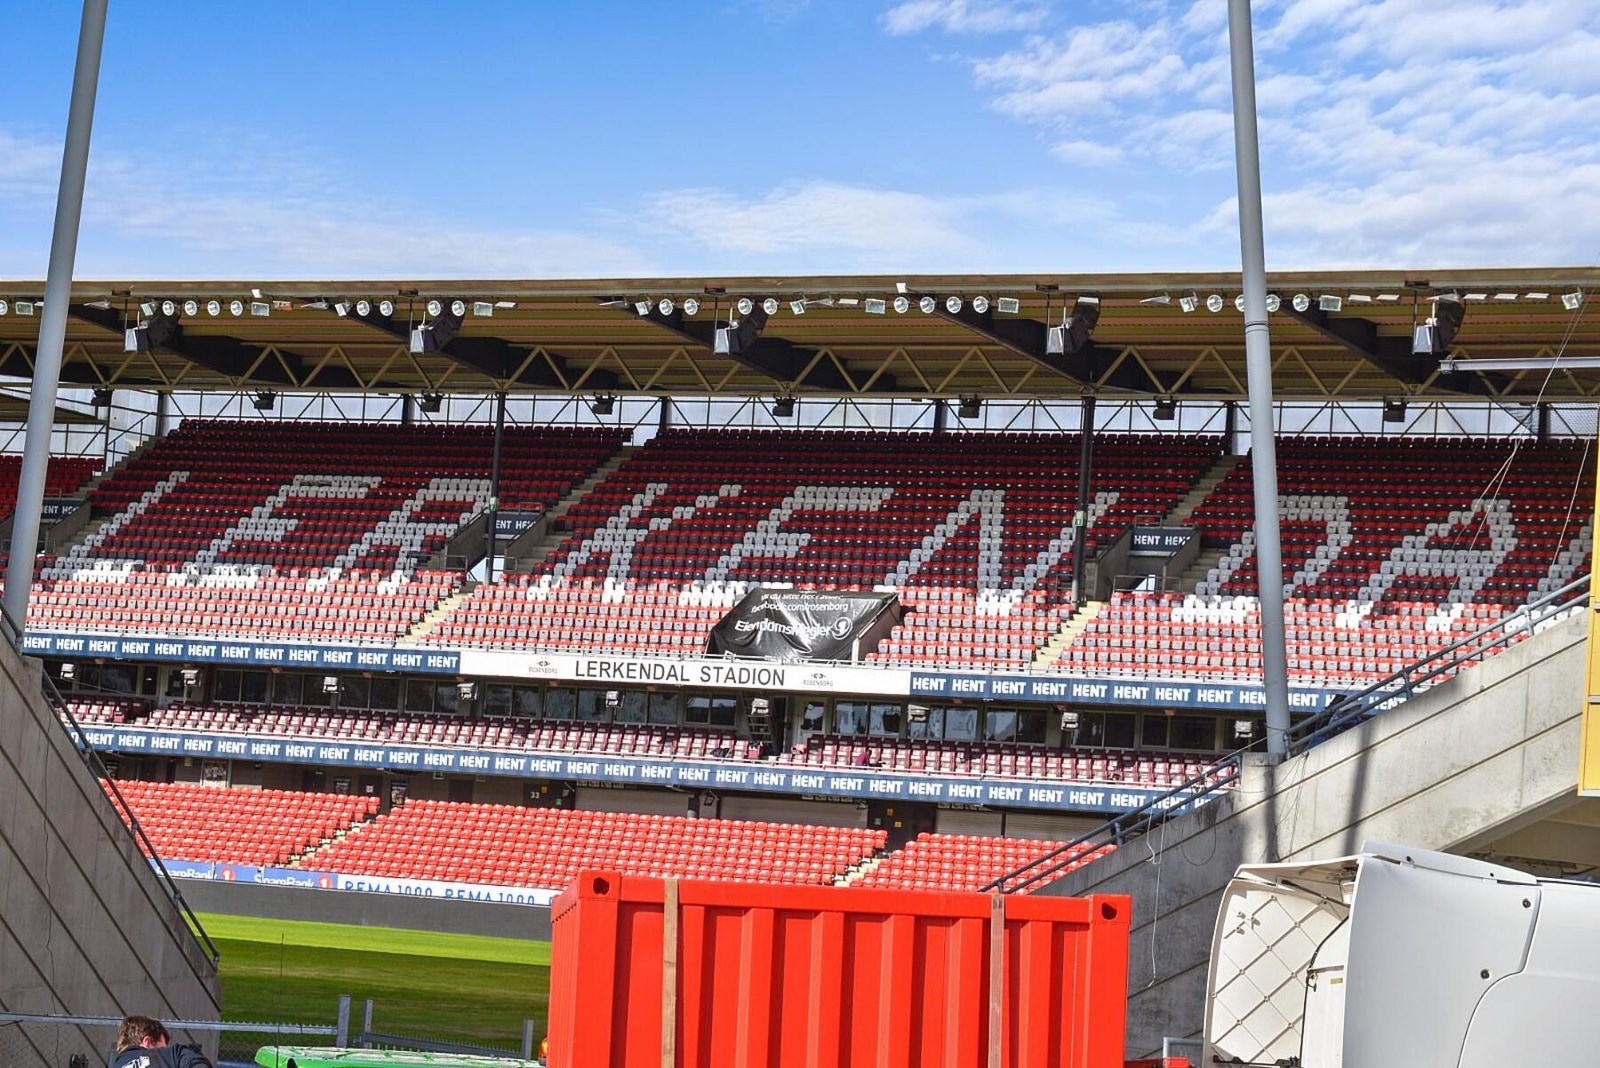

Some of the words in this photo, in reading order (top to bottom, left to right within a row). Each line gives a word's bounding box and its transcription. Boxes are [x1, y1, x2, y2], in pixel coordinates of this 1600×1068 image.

[40, 505, 59, 515] ENT
[1133, 534, 1161, 546] HENT
[23, 636, 52, 649] HENT
[56, 638, 85, 651] HENT
[88, 640, 118, 653] HENT
[121, 641, 150, 654] HENT
[154, 643, 184, 656] HENT
[188, 644, 217, 657] HENT
[221, 646, 251, 659] HENT
[255, 647, 284, 661] HENT
[289, 649, 319, 662] HENT
[323, 650, 353, 664] HENT
[357, 652, 388, 665] HENT
[392, 653, 423, 667] HENT
[427, 655, 458, 668] HENT
[574, 660, 690, 682] LERKENDAL
[699, 665, 785, 686] STADION
[912, 677, 947, 691] HENT
[951, 678, 987, 693] HENT
[992, 680, 1027, 694] HENT
[1032, 682, 1067, 696] HENT
[1072, 683, 1108, 698] HENT
[1113, 685, 1150, 700] HENT
[1155, 687, 1191, 702] HENT
[1197, 689, 1234, 703] HENT
[1239, 690, 1267, 705] HEN
[85, 732, 115, 746] HENT
[118, 734, 147, 748] HENT
[150, 736, 181, 750] HENT
[183, 738, 213, 752] HENT
[217, 740, 248, 754] HENT
[251, 742, 281, 756] HENT
[285, 744, 316, 758] HENT
[319, 747, 350, 760] HENT
[353, 748, 385, 763] HENT
[389, 751, 419, 765] HENT
[424, 752, 455, 767] HENT
[459, 755, 490, 769] HENT
[494, 756, 527, 771] HENT
[530, 759, 562, 773] HENT
[567, 761, 600, 775] HENT
[604, 763, 636, 777] HENT
[641, 764, 674, 779] HENT
[678, 767, 711, 781] HENT
[715, 769, 749, 784] HENT
[753, 771, 786, 786] HENT
[791, 774, 825, 789] HENT
[830, 777, 864, 791] HENT
[869, 779, 904, 794] HENT
[908, 781, 943, 796] HENT
[948, 783, 984, 799] HENT
[988, 786, 1023, 801] HENT
[1028, 788, 1064, 803] HENT
[1069, 790, 1105, 806] HENT
[1110, 793, 1147, 808] HENT
